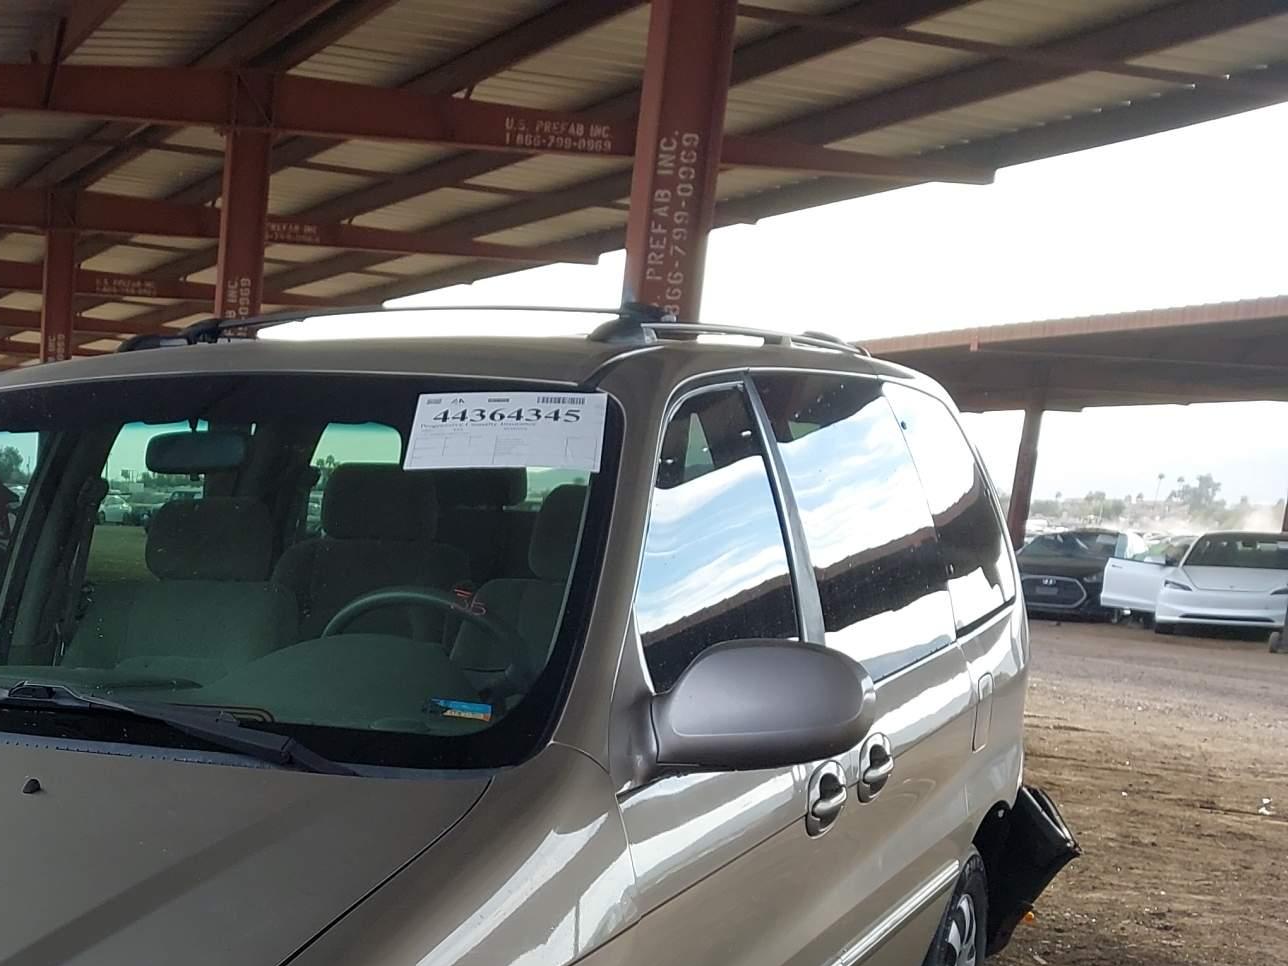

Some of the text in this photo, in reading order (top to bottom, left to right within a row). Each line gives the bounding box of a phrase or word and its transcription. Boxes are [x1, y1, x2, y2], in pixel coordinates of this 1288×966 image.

[535, 119, 585, 137] PREFAB
[646, 129, 681, 281] PREFAB INC.
[432, 407, 581, 423] 44364345
